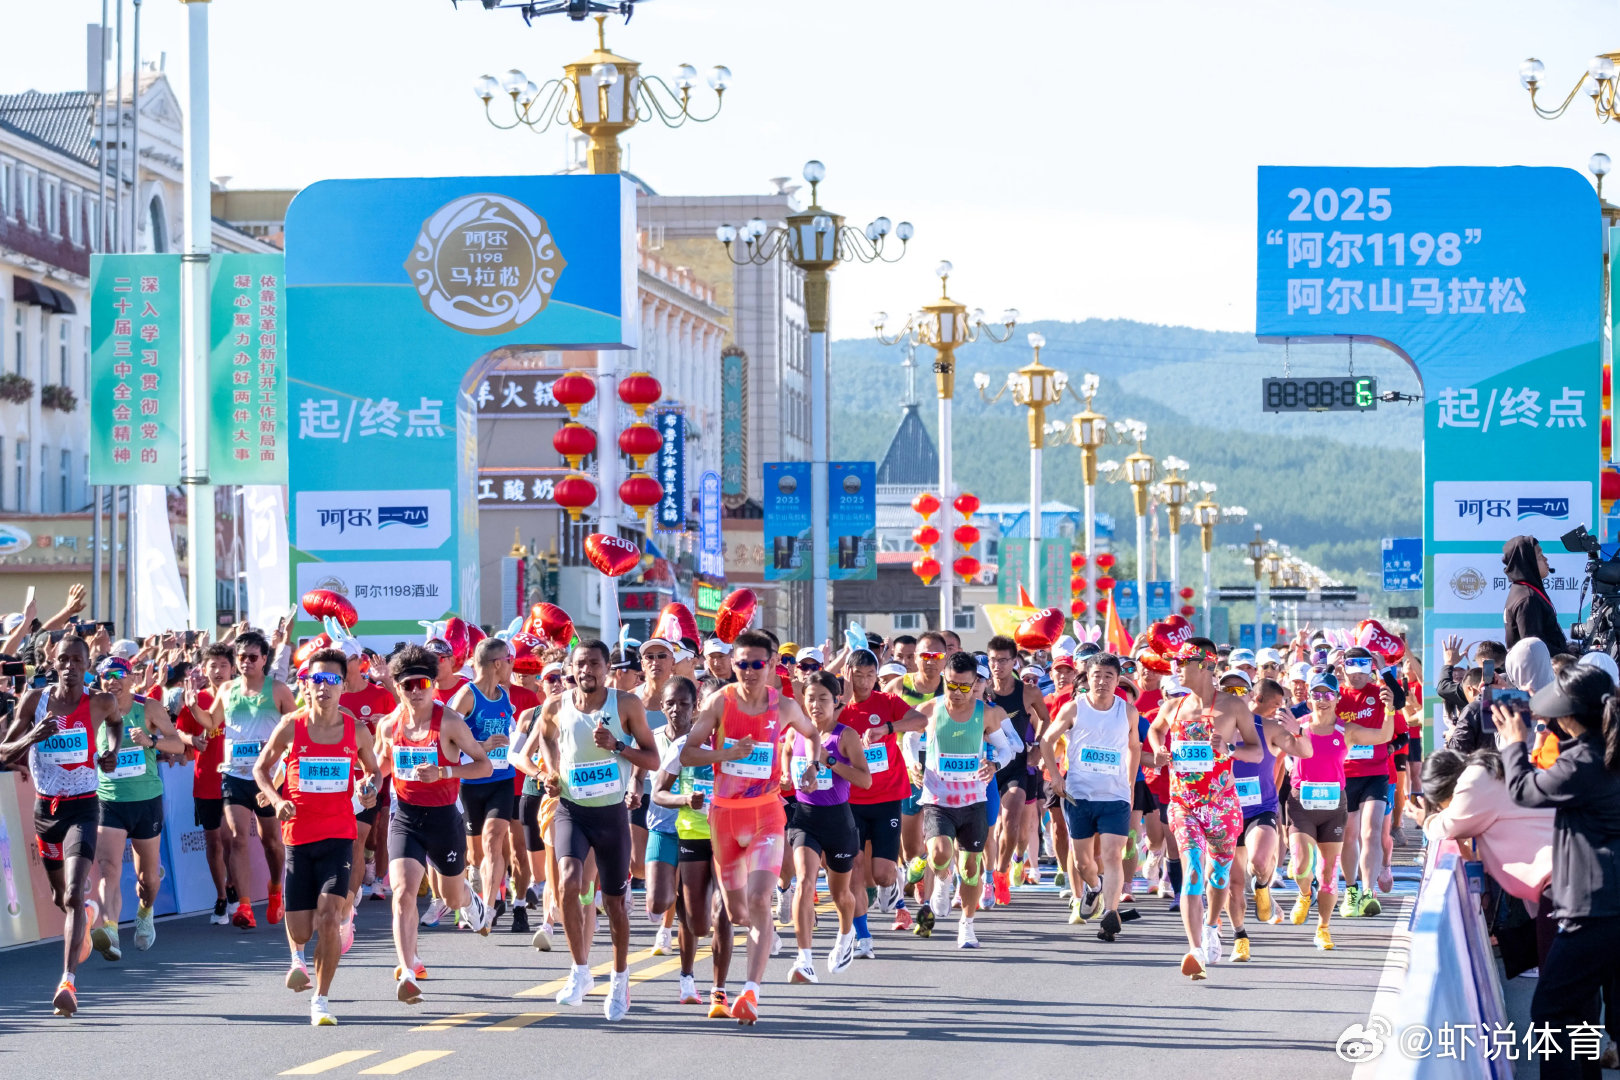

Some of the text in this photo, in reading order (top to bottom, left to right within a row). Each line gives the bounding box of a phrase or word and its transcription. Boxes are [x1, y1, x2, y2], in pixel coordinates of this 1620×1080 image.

[1288, 187, 1392, 222] 2025
[462, 230, 508, 250] 阿尔
[1266, 228, 1482, 268] “阿尔1198”
[469, 253, 503, 264] 1198
[450, 266, 520, 288] 马拉松
[1288, 277, 1527, 315] 阿尔山马拉松
[113, 277, 132, 464] 二十届三中全会精神
[140, 276, 159, 464] 深入学习贯彻党的
[233, 274, 251, 462] 凝心聚力办好两件大事
[259, 274, 277, 462] 依靠改革创新打开工作新局面
[1437, 386, 1587, 433] 起/终点
[299, 397, 445, 443] 起/终点
[776, 496, 800, 504] 2025
[840, 496, 865, 504] 2025
[1455, 498, 1567, 525] 阿尔 一一九八
[316, 508, 427, 535] 阿尔 一一九八
[600, 536, 634, 553] 4:00
[355, 584, 439, 599] 阿尔1198酒业
[1166, 625, 1193, 645] 5:00
[43, 736, 82, 749] A0008
[236, 745, 259, 755] A041
[487, 750, 507, 759] 301
[864, 750, 883, 761] 259
[1085, 751, 1116, 763] A0353
[1174, 748, 1207, 759] A0336
[308, 766, 341, 777] 陈柏发
[944, 760, 975, 770] A0315
[573, 768, 613, 783] A0454
